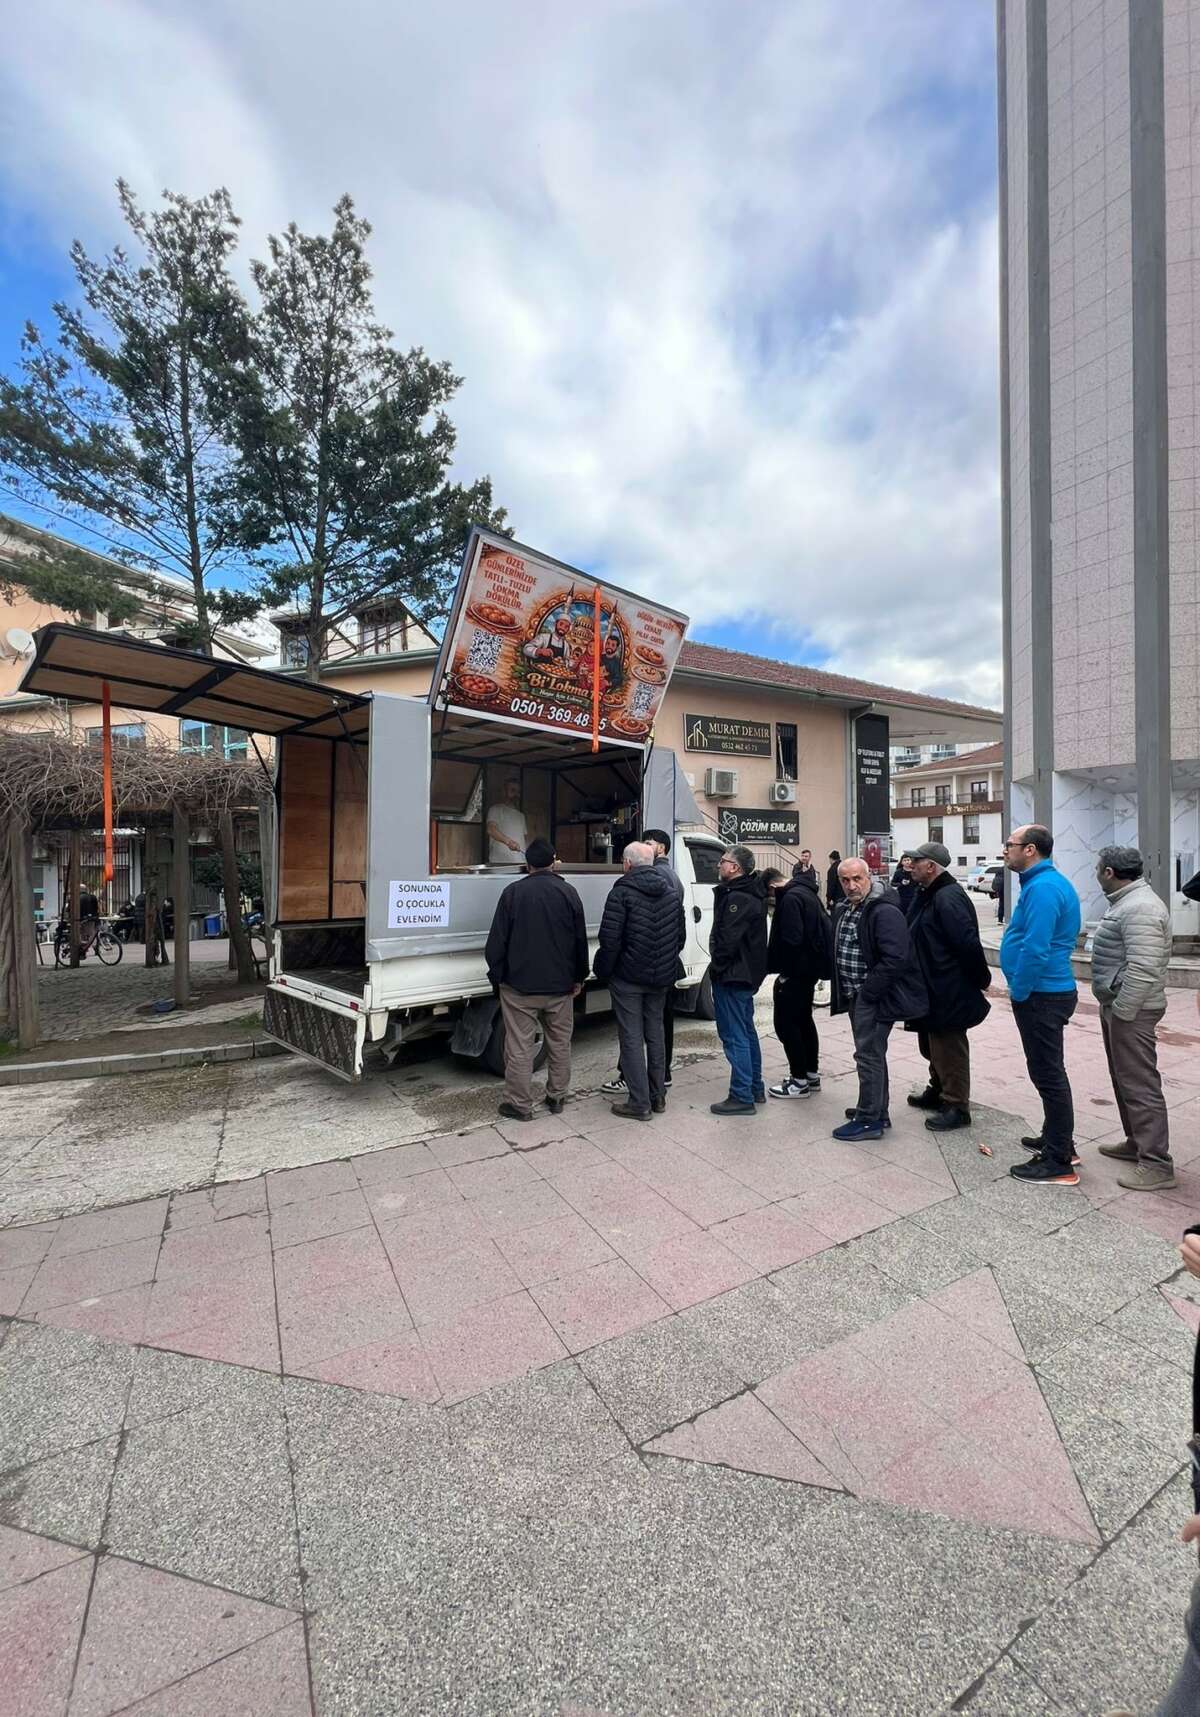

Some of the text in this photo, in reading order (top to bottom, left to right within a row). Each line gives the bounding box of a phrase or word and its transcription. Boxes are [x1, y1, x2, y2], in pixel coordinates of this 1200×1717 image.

[484, 570, 504, 584] TATLI
[492, 583, 520, 599] LOKMA
[510, 697, 544, 717] 0501
[547, 706, 572, 723] 369
[574, 712, 590, 727] 48
[708, 723, 740, 736] MURAT
[740, 818, 797, 833] ÇÖZÜM EMLAK
[398, 884, 442, 893] SONUNDA
[396, 900, 445, 910] O ÇOCUKLA
[397, 914, 442, 924] EVLENDİM
